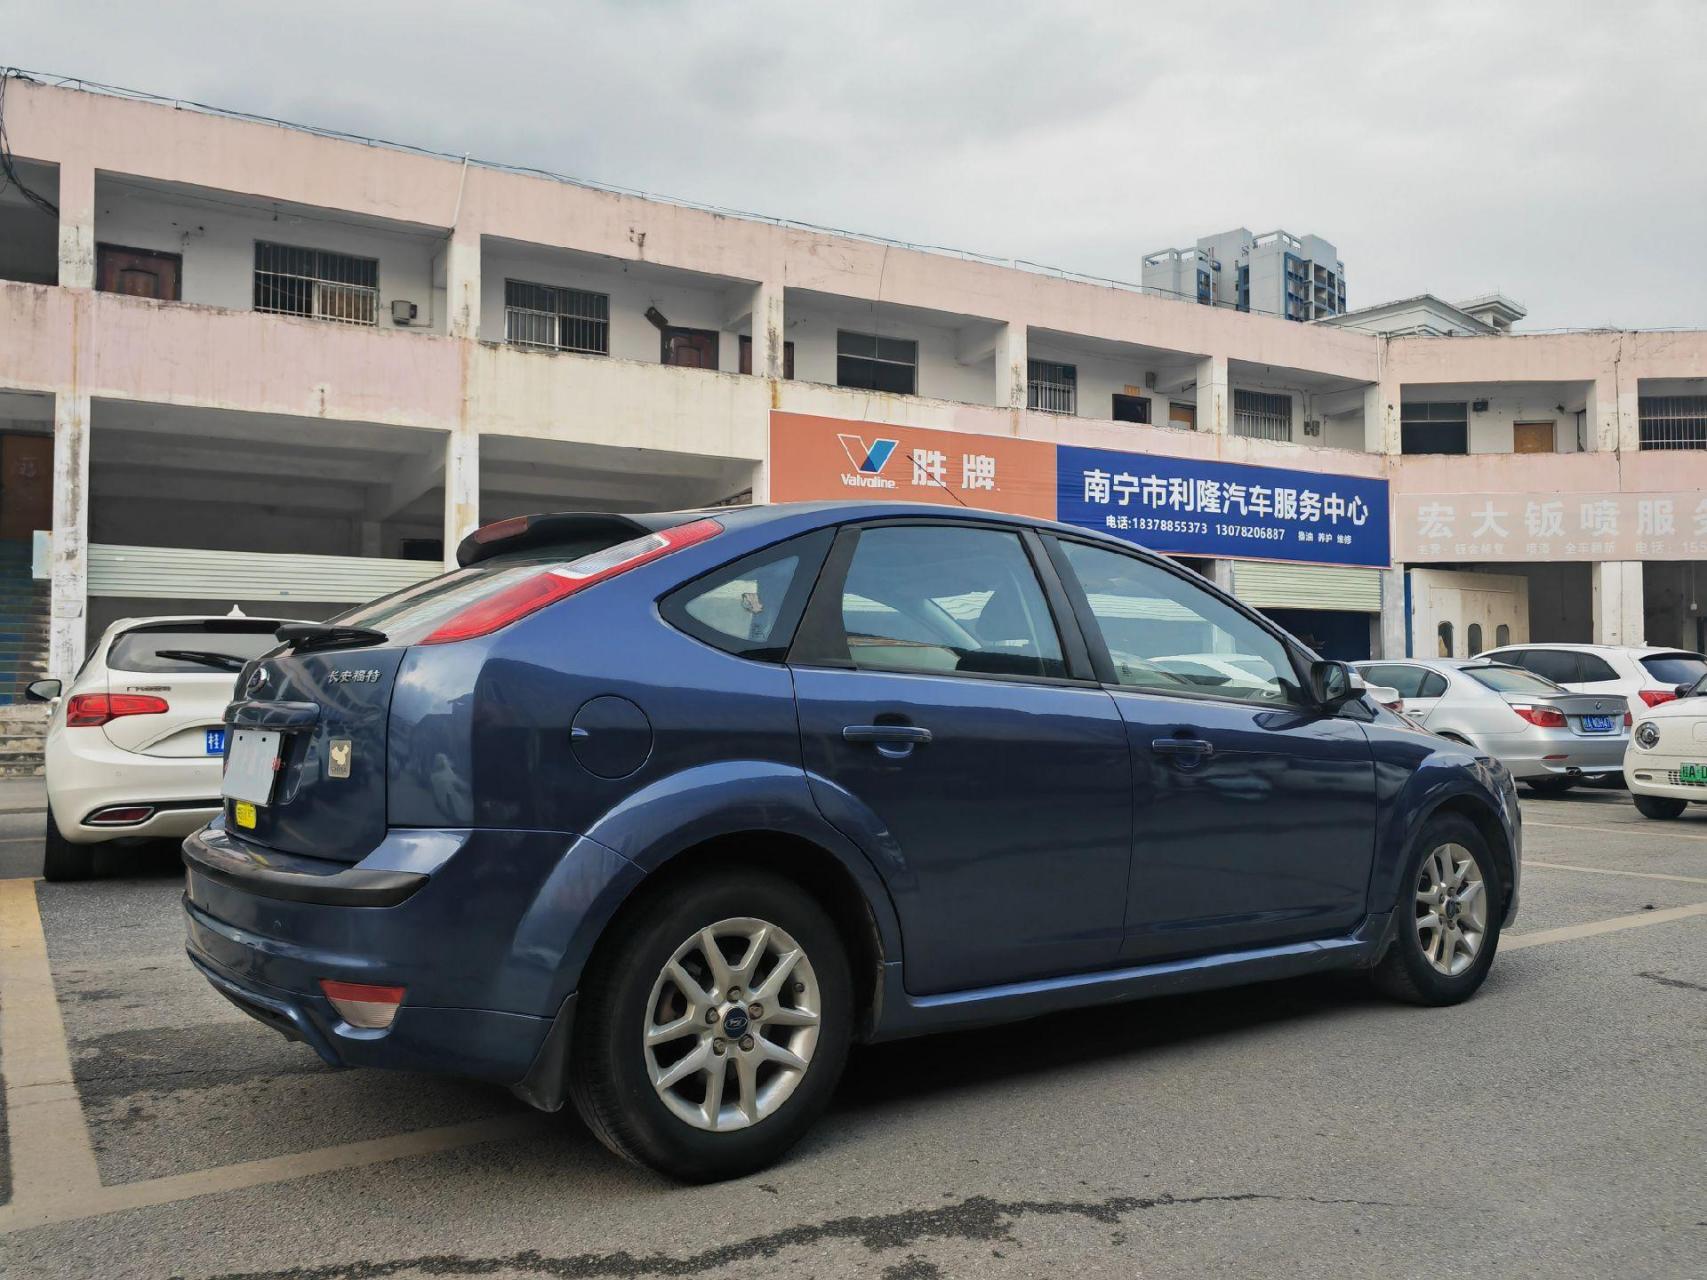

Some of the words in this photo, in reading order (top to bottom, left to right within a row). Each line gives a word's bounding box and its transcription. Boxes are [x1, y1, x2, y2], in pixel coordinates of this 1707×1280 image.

[911, 448, 995, 491] 胜牌
[841, 473, 897, 489] Valvoline
[1083, 469, 1369, 526] 南宁市利隆汽车服务中心
[1215, 524, 1286, 541] 13078206887
[328, 669, 381, 684] 长安福特
